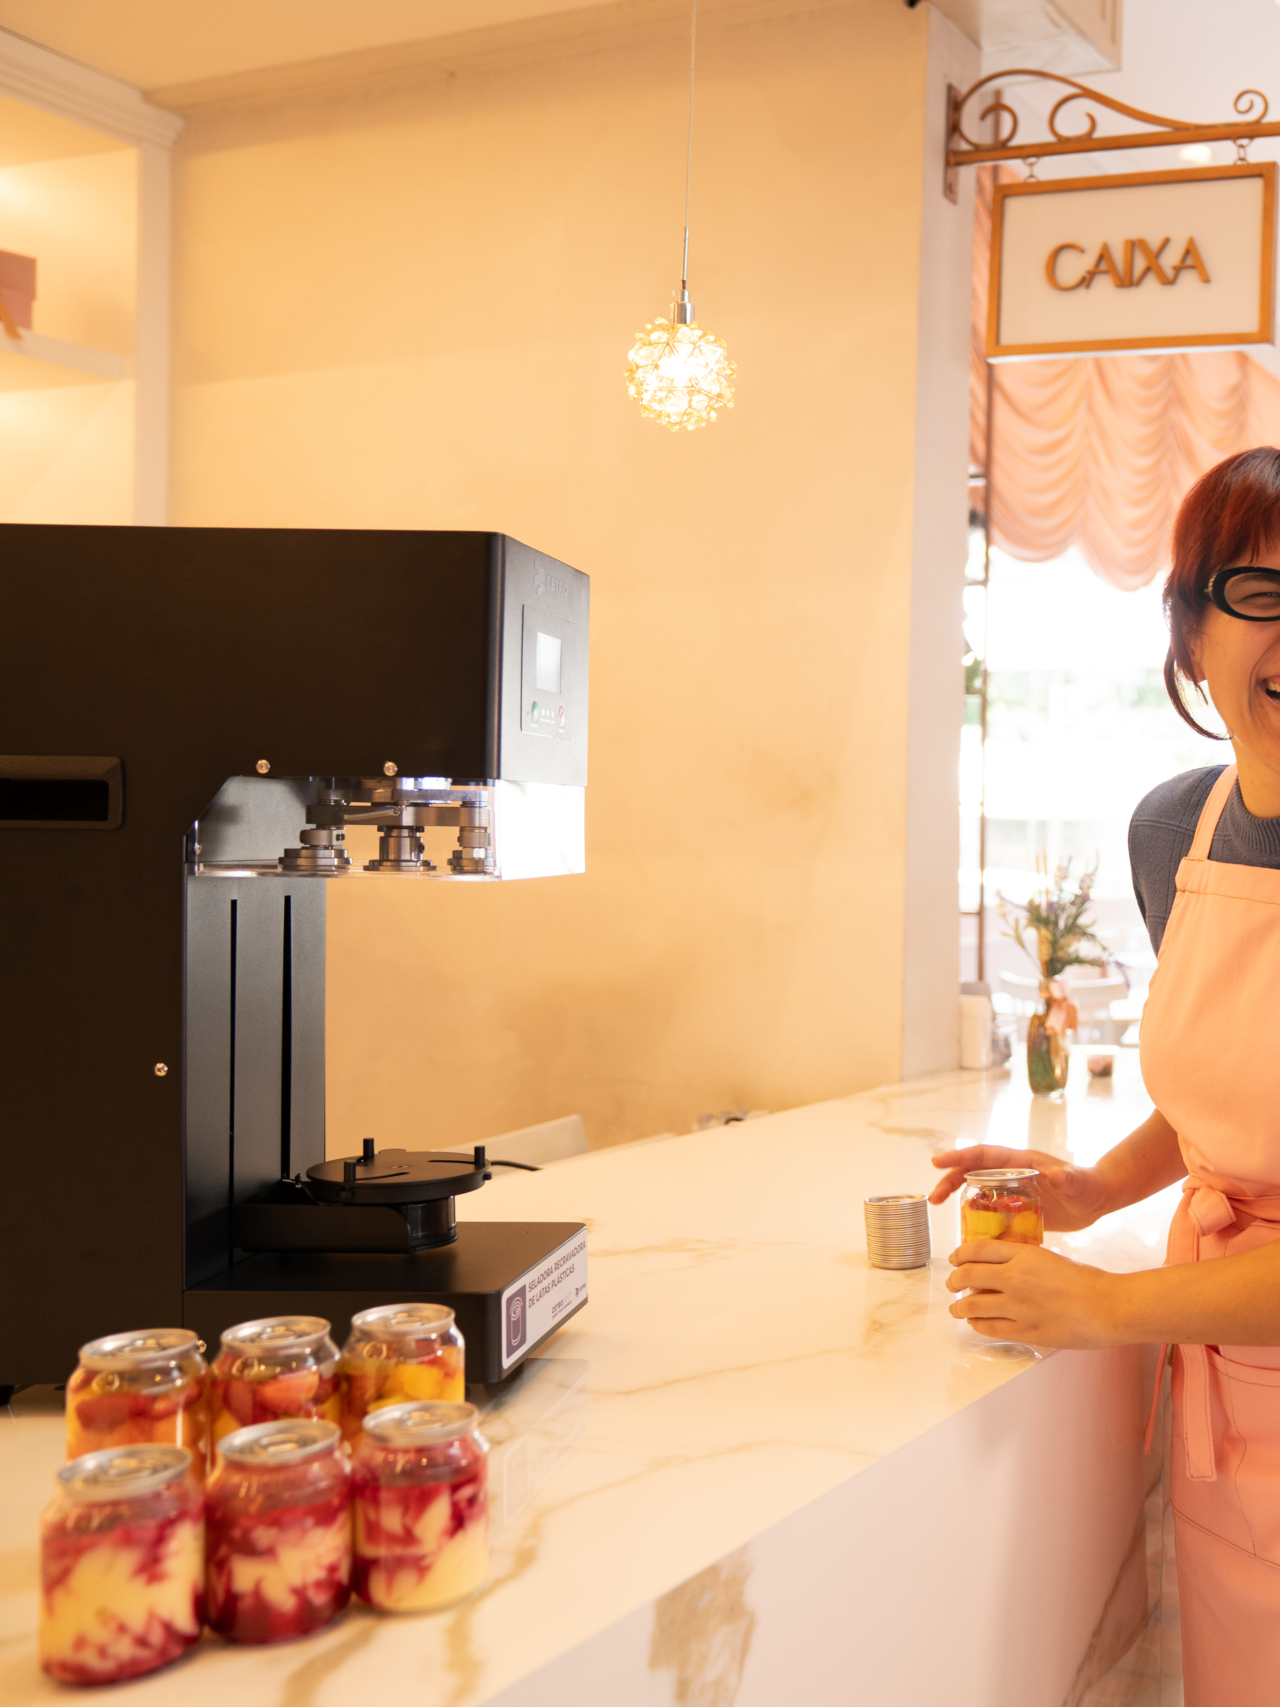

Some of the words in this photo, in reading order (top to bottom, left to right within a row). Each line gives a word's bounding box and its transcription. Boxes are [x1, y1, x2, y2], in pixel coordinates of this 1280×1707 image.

[1046, 236, 1210, 291] CAIXA
[528, 1266, 553, 1293] SELADORA
[554, 1241, 586, 1273] RECRAVADORA
[528, 1295, 535, 1309] DE
[536, 1283, 551, 1304] LATAS
[551, 1263, 575, 1290] PLÁSTICAS
